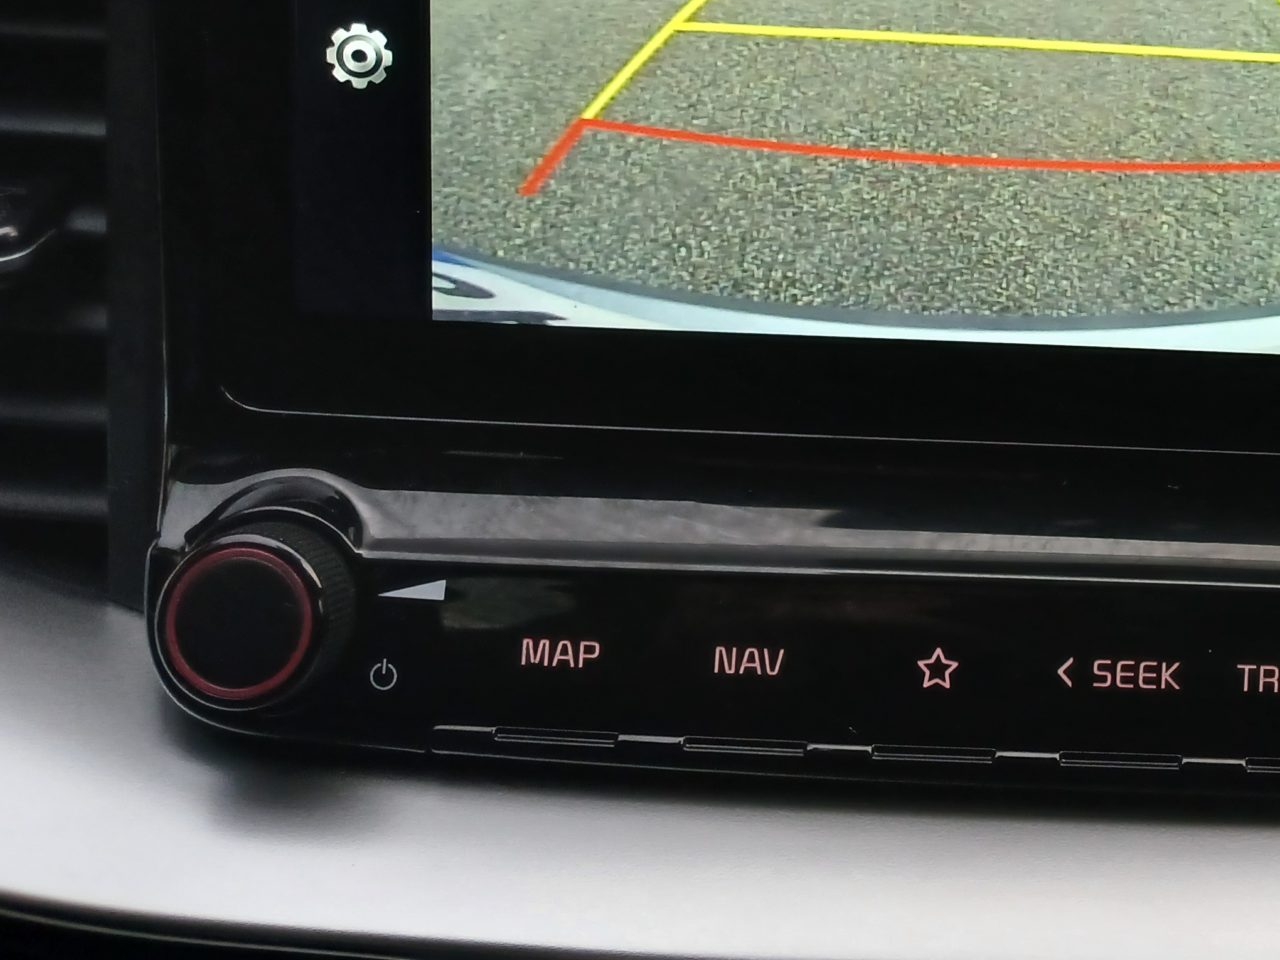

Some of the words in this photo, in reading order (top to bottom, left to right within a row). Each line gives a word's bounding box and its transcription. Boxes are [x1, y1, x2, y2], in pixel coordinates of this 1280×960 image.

[520, 638, 601, 669] MAP
[713, 646, 786, 677] NAV
[1092, 659, 1181, 690] SEEK
